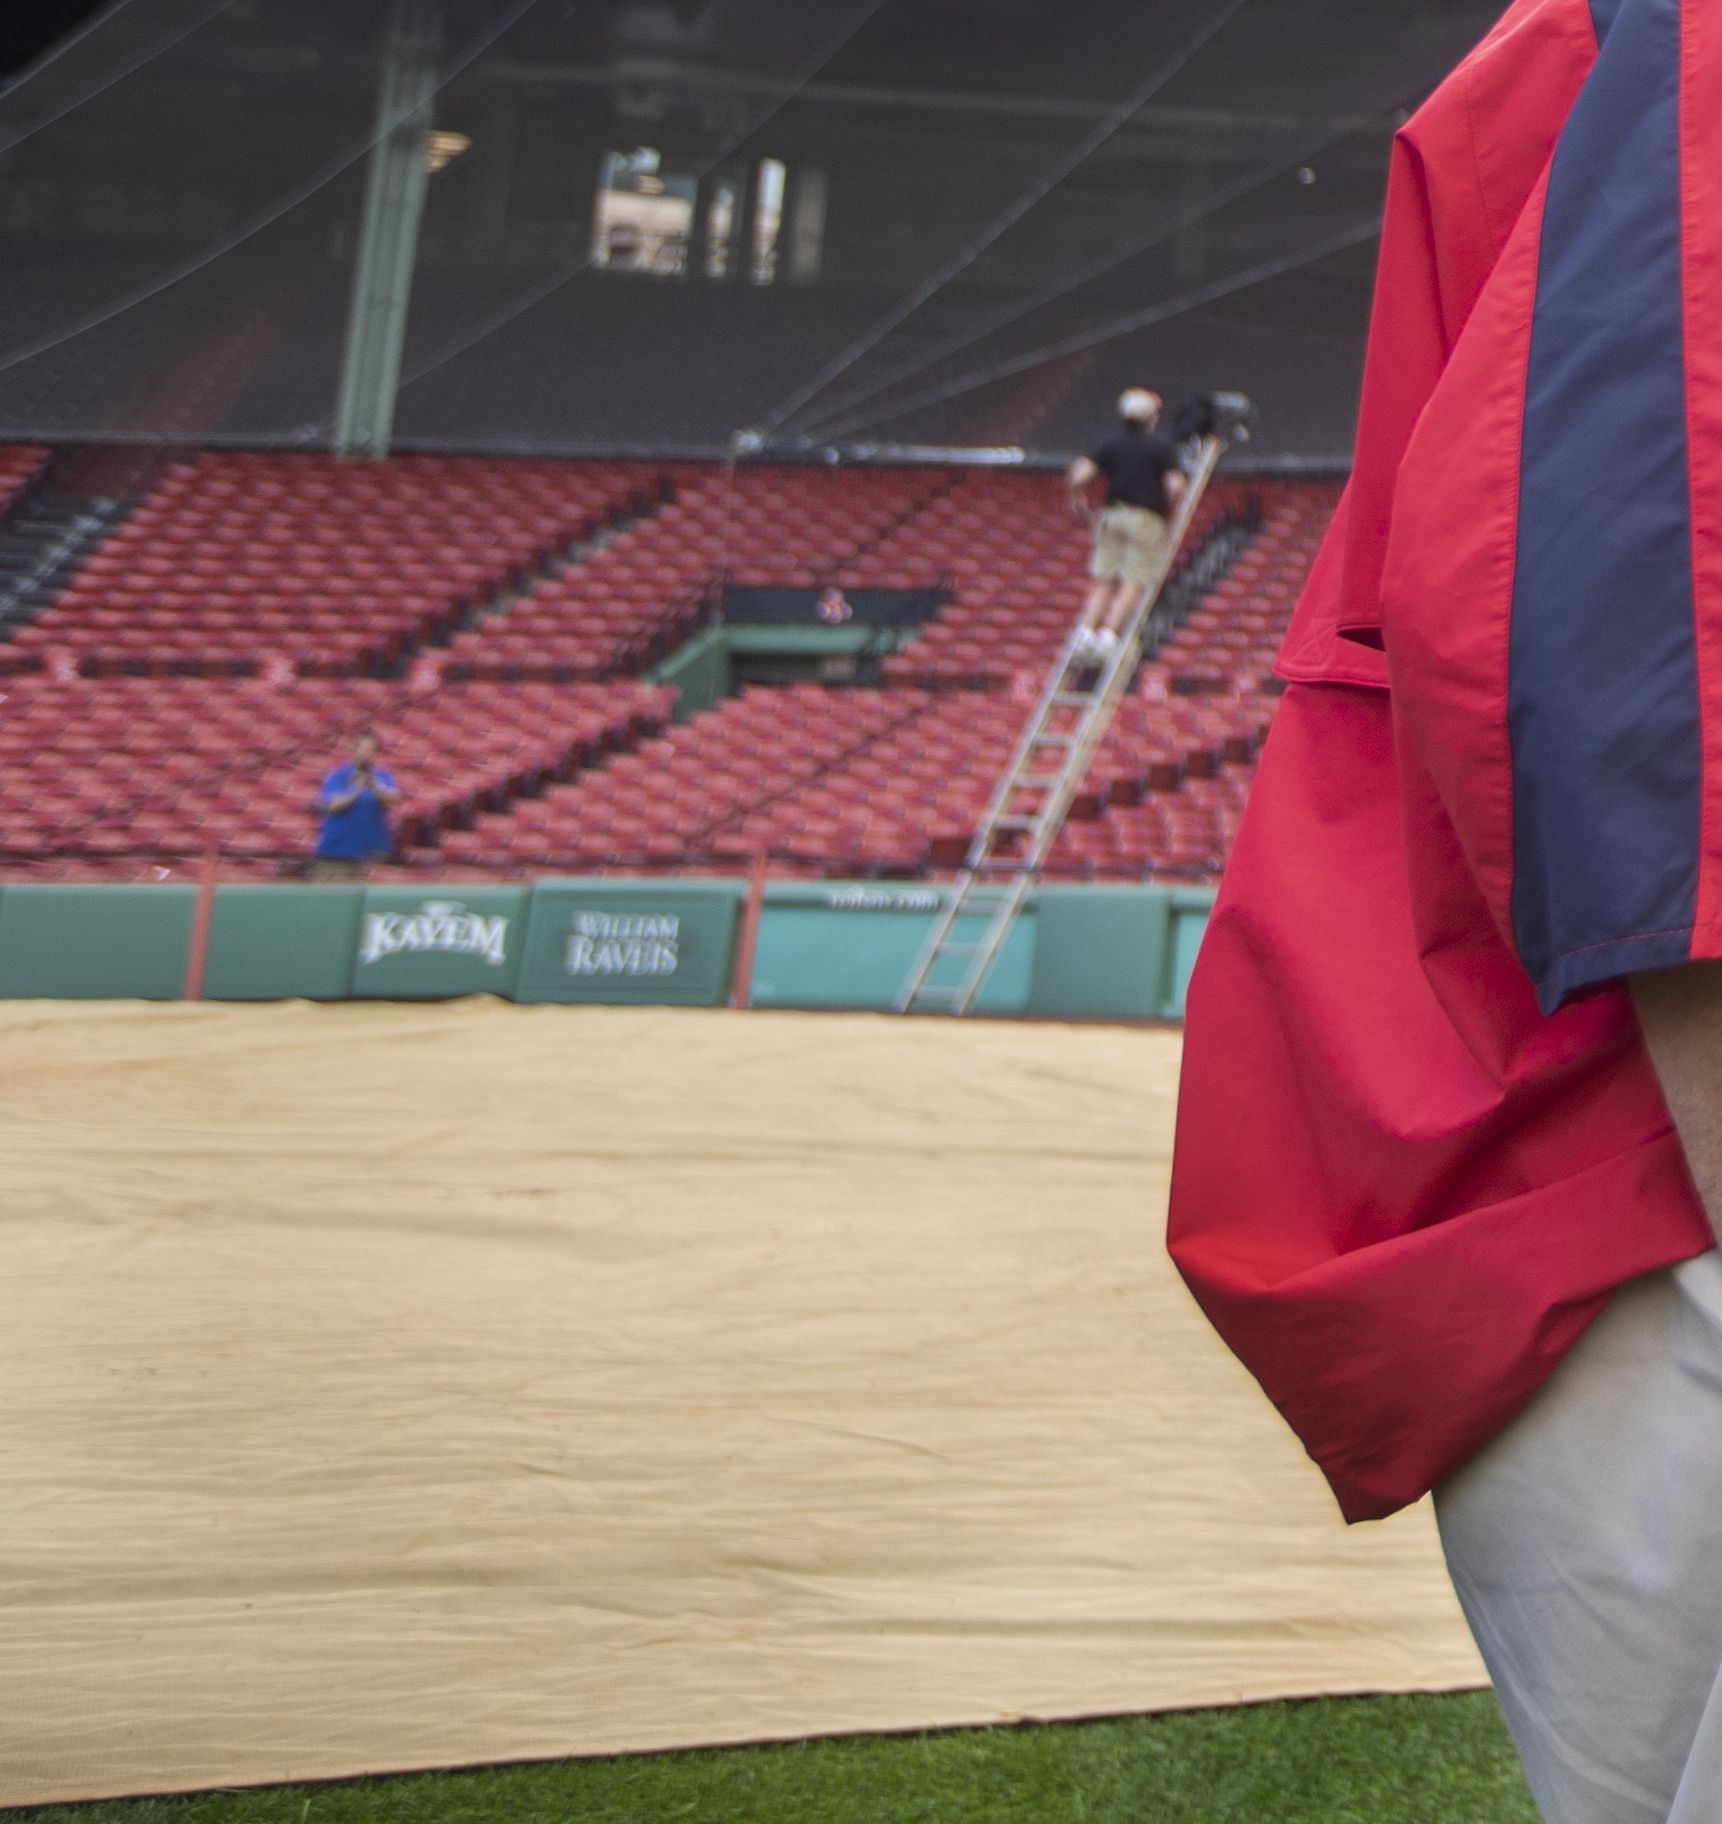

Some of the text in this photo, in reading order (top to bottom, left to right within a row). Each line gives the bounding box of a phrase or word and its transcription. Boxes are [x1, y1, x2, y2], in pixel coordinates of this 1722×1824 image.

[358, 912, 511, 965] KAYEM
[573, 910, 681, 940] WILLIAM
[564, 935, 681, 976] RAVEIS
